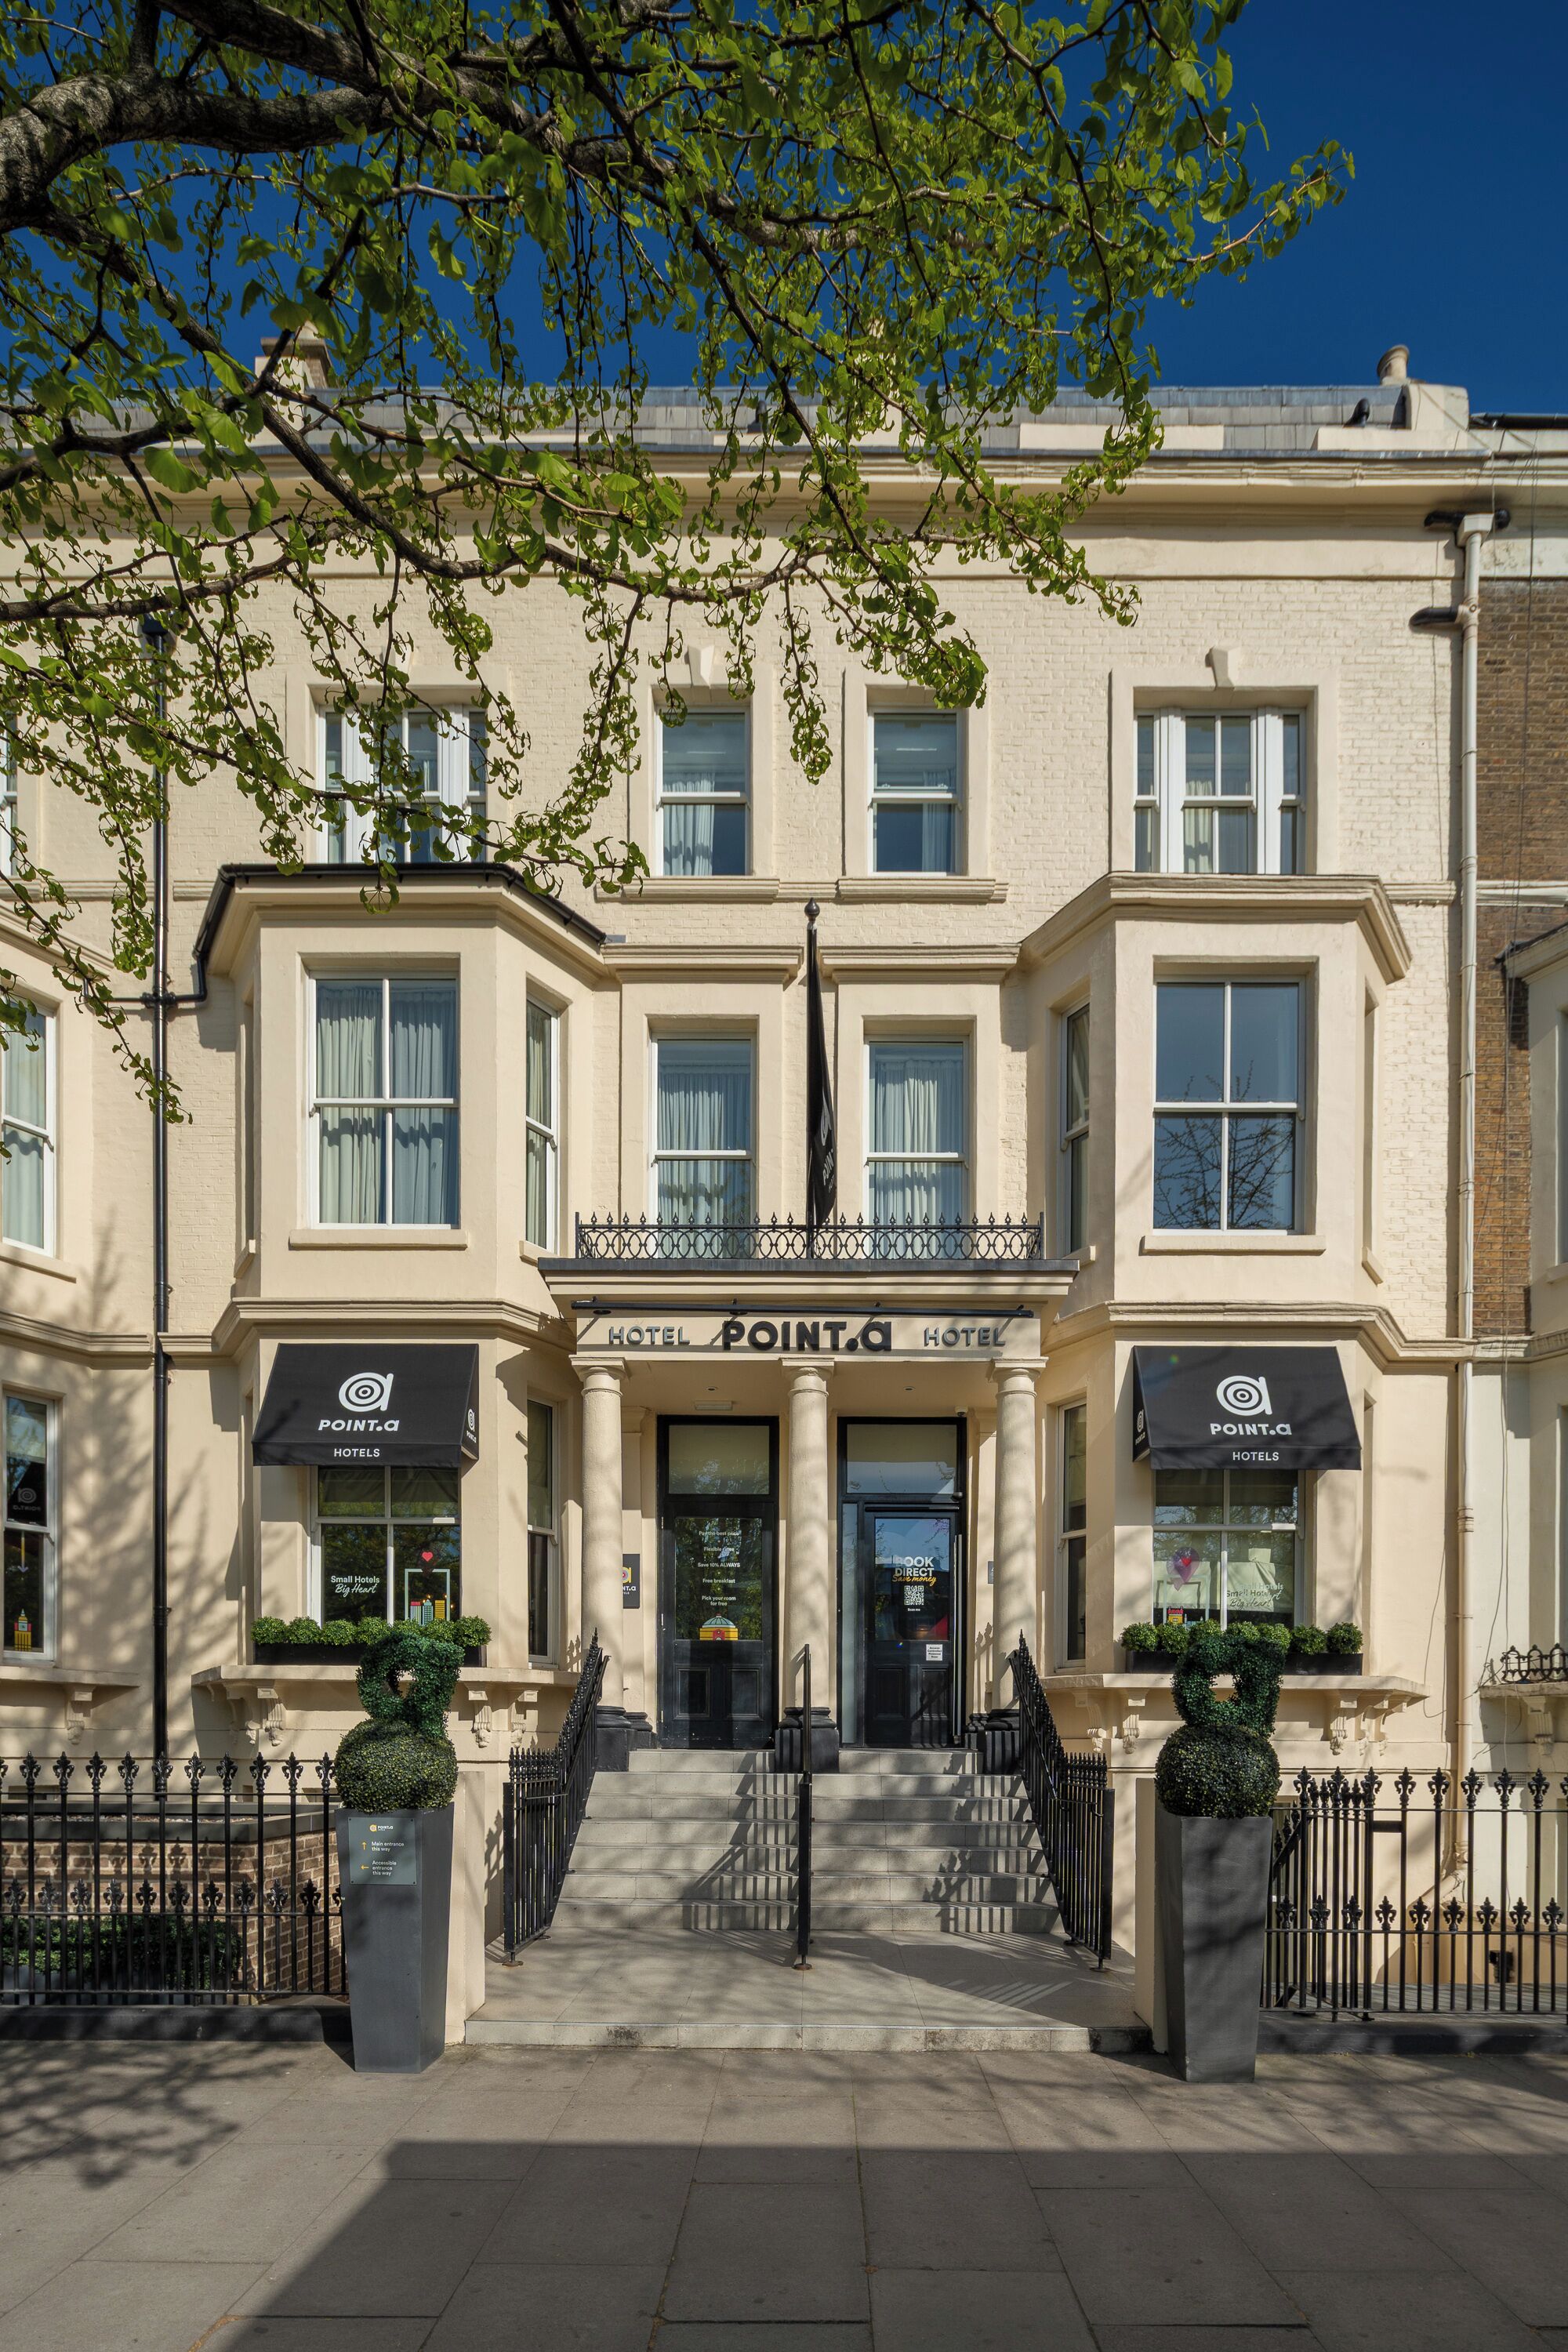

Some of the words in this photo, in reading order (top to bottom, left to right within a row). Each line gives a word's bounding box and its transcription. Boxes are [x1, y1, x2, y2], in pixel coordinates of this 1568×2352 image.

[609, 1326, 690, 1345] HOTEL
[722, 1320, 892, 1351] POINT.a
[924, 1327, 1006, 1346] HOTEL
[318, 1419, 400, 1432] POINT.a
[1210, 1423, 1292, 1436] POINT.a
[334, 1448, 380, 1457] HOTELS
[1232, 1451, 1279, 1461] HOTELS
[895, 1567, 935, 1577] DIRECT
[891, 1573, 911, 1582] Save
[911, 1577, 937, 1587] money
[336, 1584, 350, 1597] Big
[351, 1583, 378, 1593] Heart
